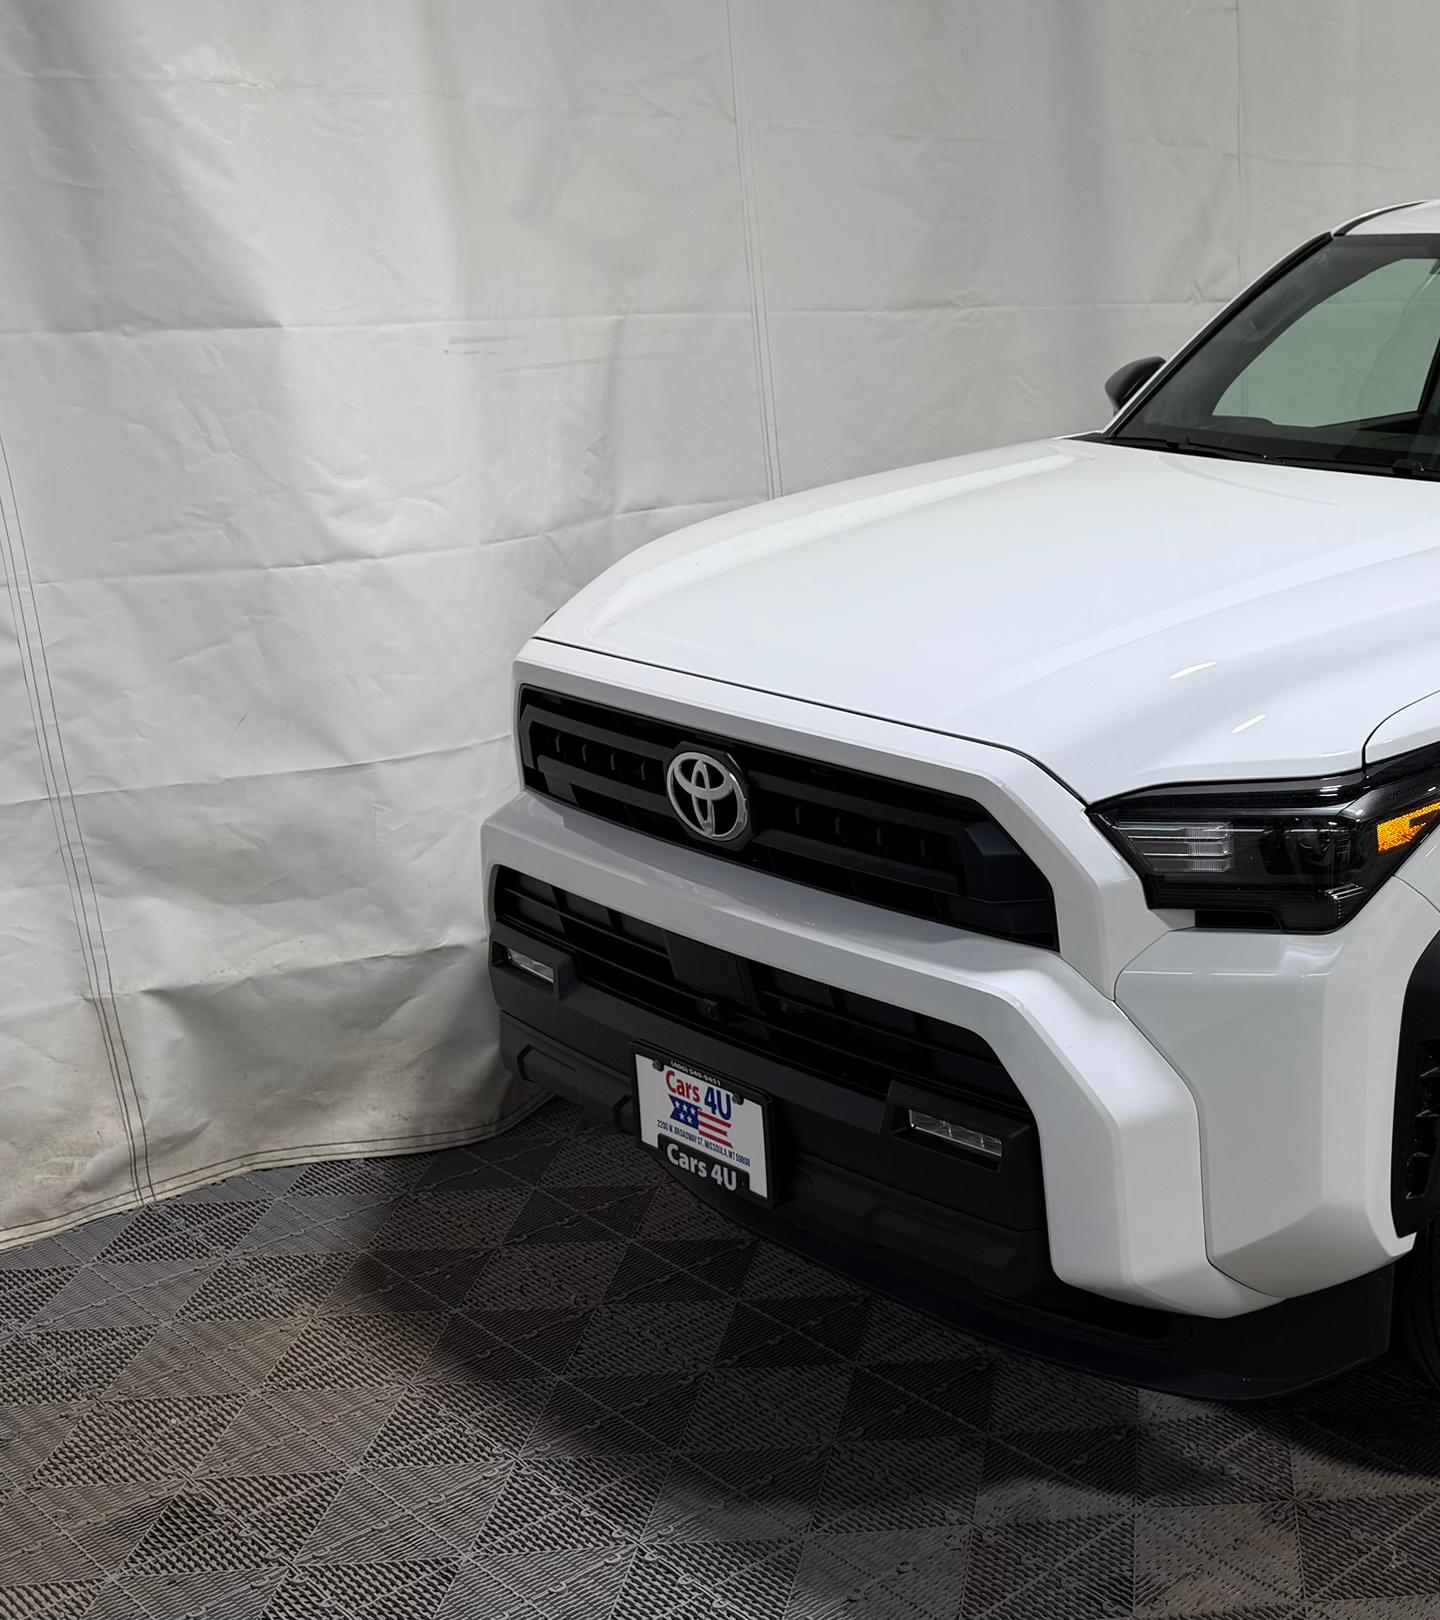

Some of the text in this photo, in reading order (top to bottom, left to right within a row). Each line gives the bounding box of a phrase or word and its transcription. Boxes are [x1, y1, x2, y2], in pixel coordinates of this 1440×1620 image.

[665, 1070, 732, 1120] Cars 4U
[673, 1126, 698, 1144] BROADWAY
[667, 1143, 737, 1191] Cars 4U
